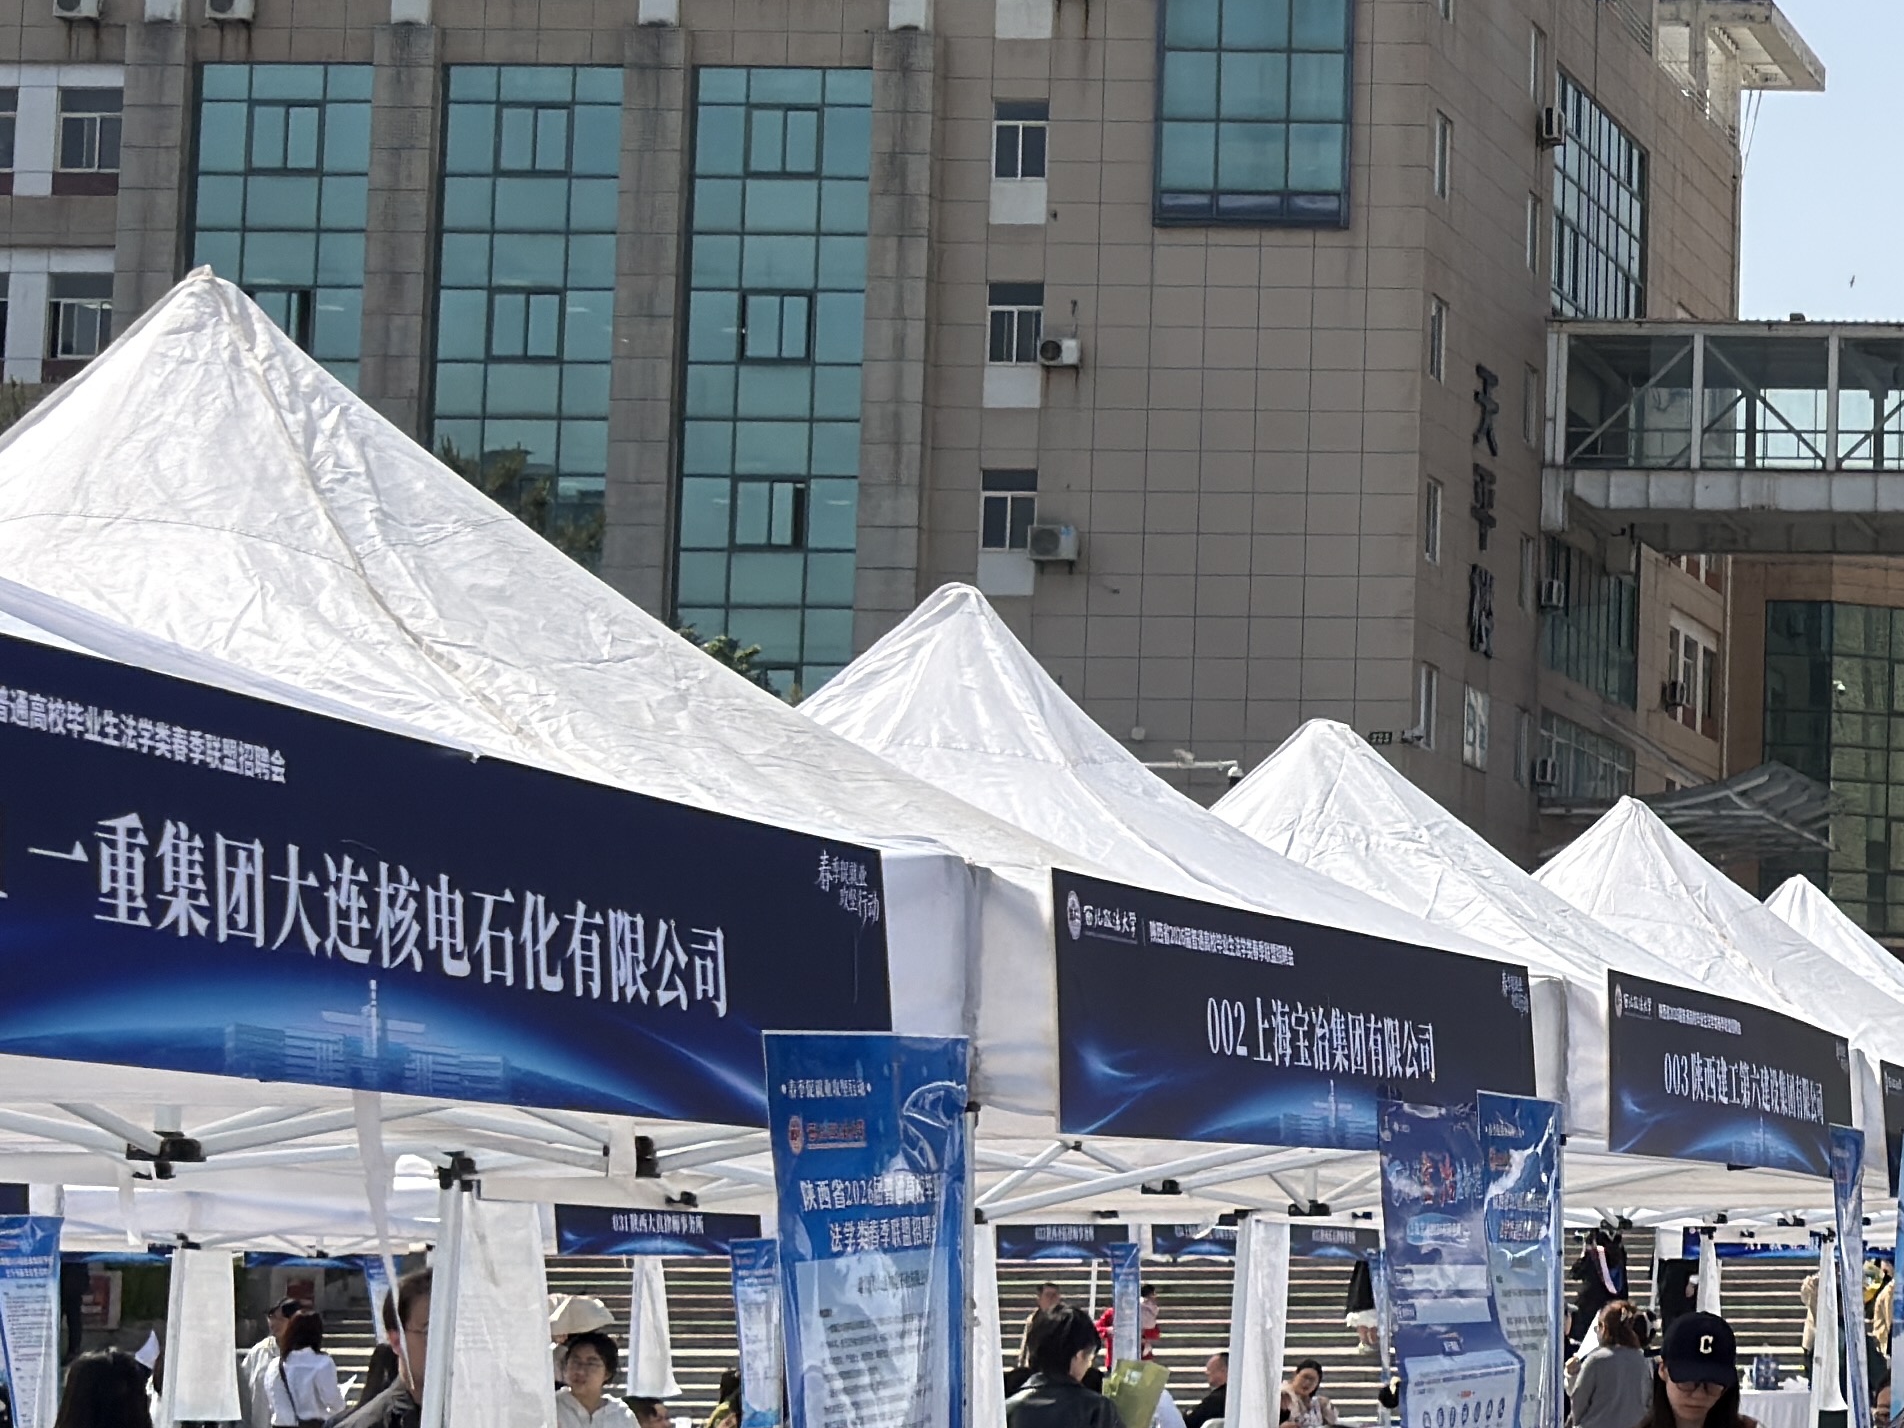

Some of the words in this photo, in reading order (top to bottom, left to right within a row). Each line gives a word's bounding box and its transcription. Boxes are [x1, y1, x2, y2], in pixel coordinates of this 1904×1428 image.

[27, 812, 728, 1018] 一重集团大连核电石化有限公司
[1206, 996, 1248, 1056] 002
[1253, 996, 1436, 1084] 上海宝冶集团有限公司
[1663, 1052, 1689, 1097] 003
[1700, 1335, 1713, 1354] C
